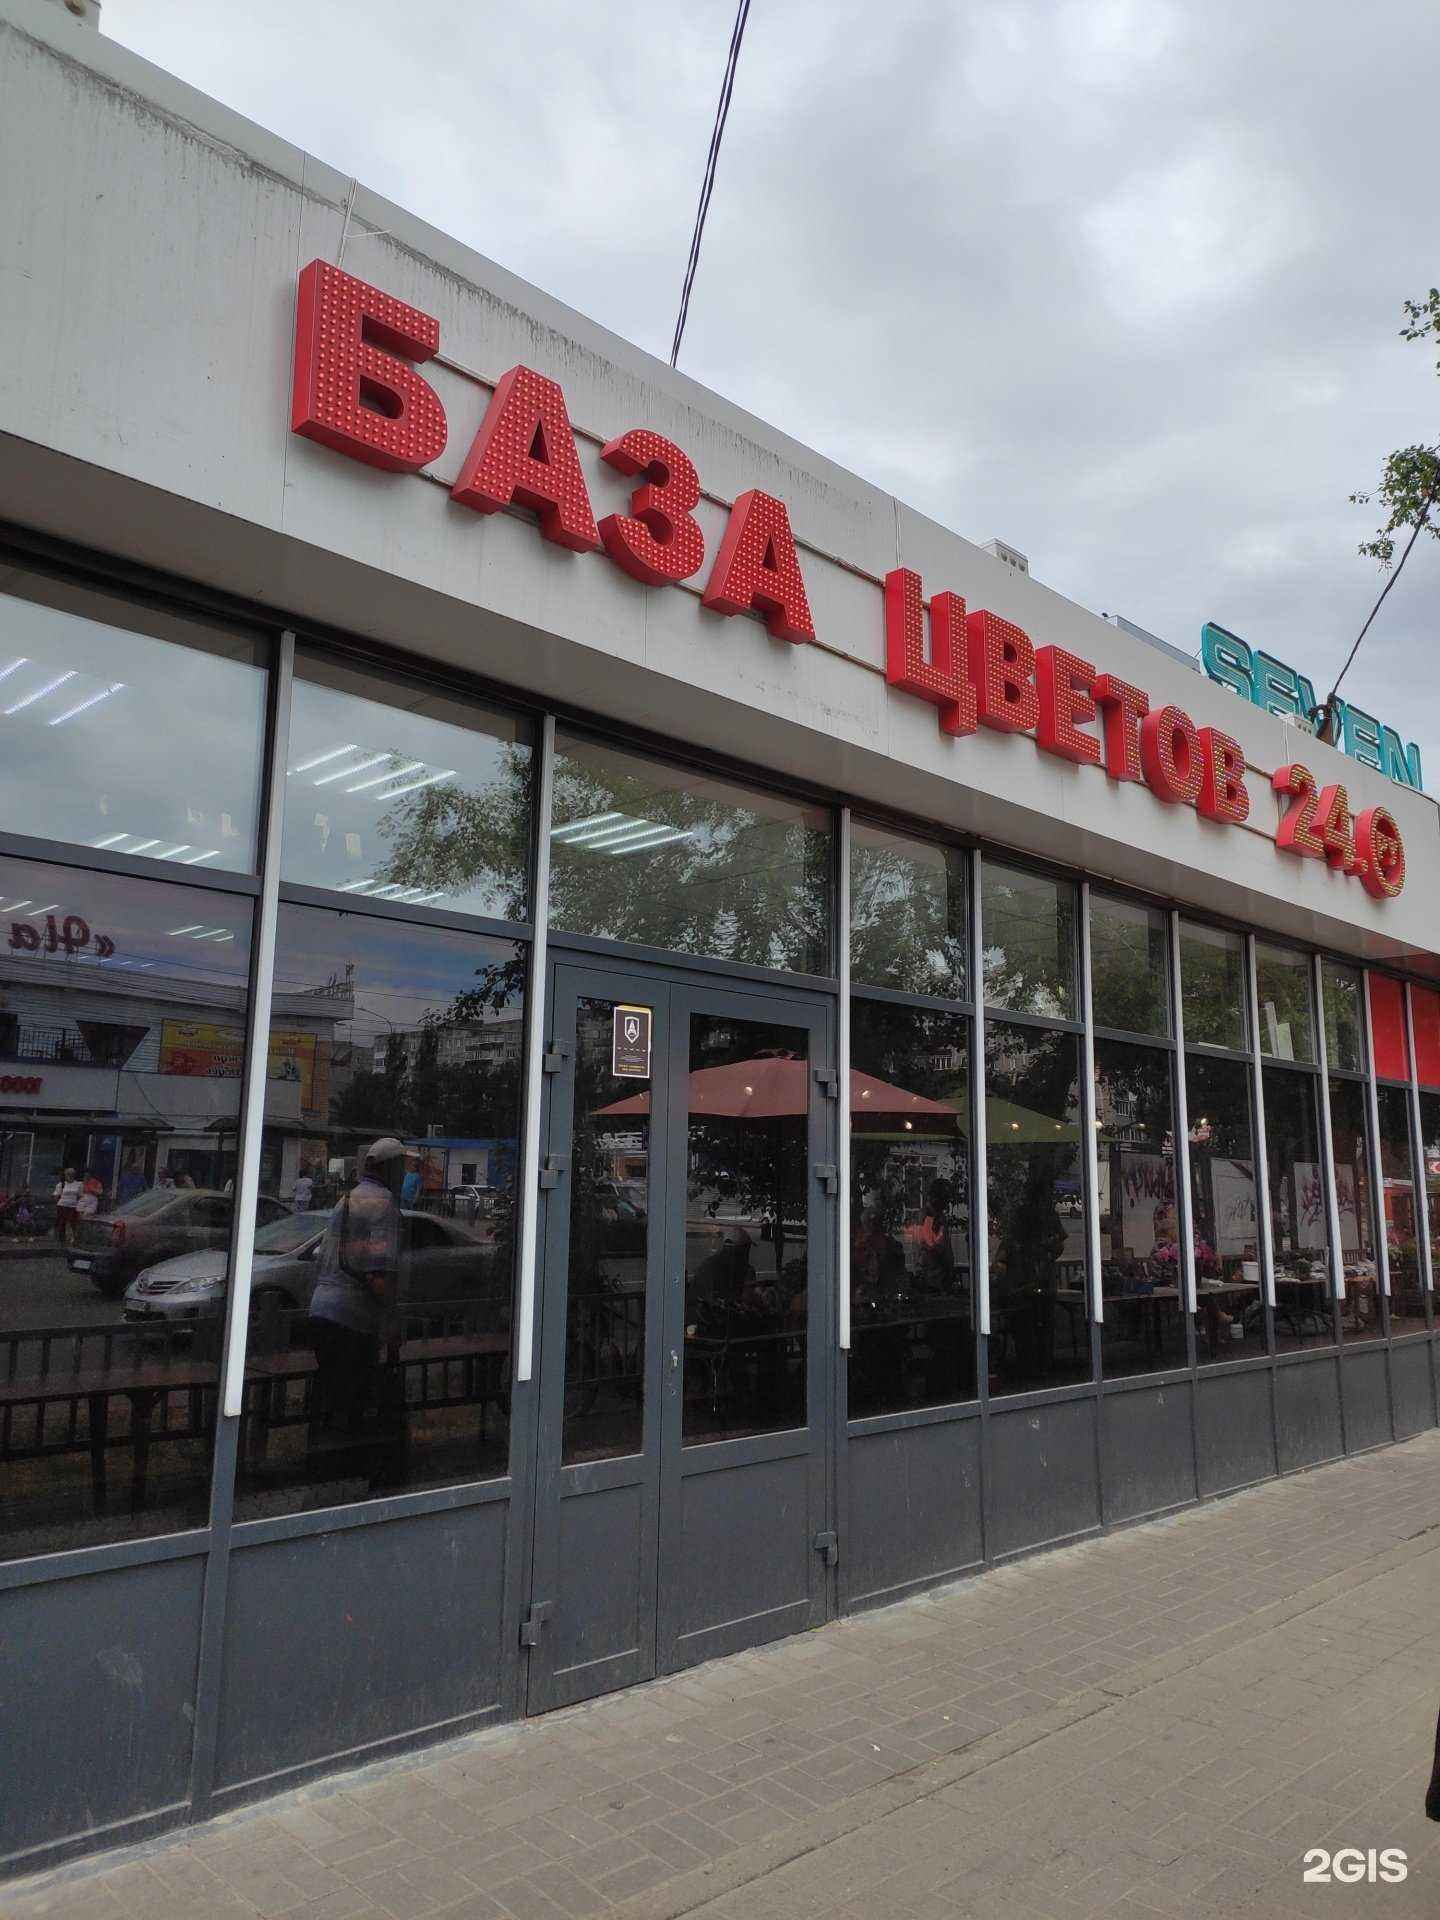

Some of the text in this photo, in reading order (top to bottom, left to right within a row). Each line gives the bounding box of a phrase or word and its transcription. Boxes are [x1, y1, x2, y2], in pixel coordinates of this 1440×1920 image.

[292, 258, 815, 645] БАЗА
[885, 567, 1250, 824] ЦВЕТОВ
[1201, 621, 1423, 791] SEVEN
